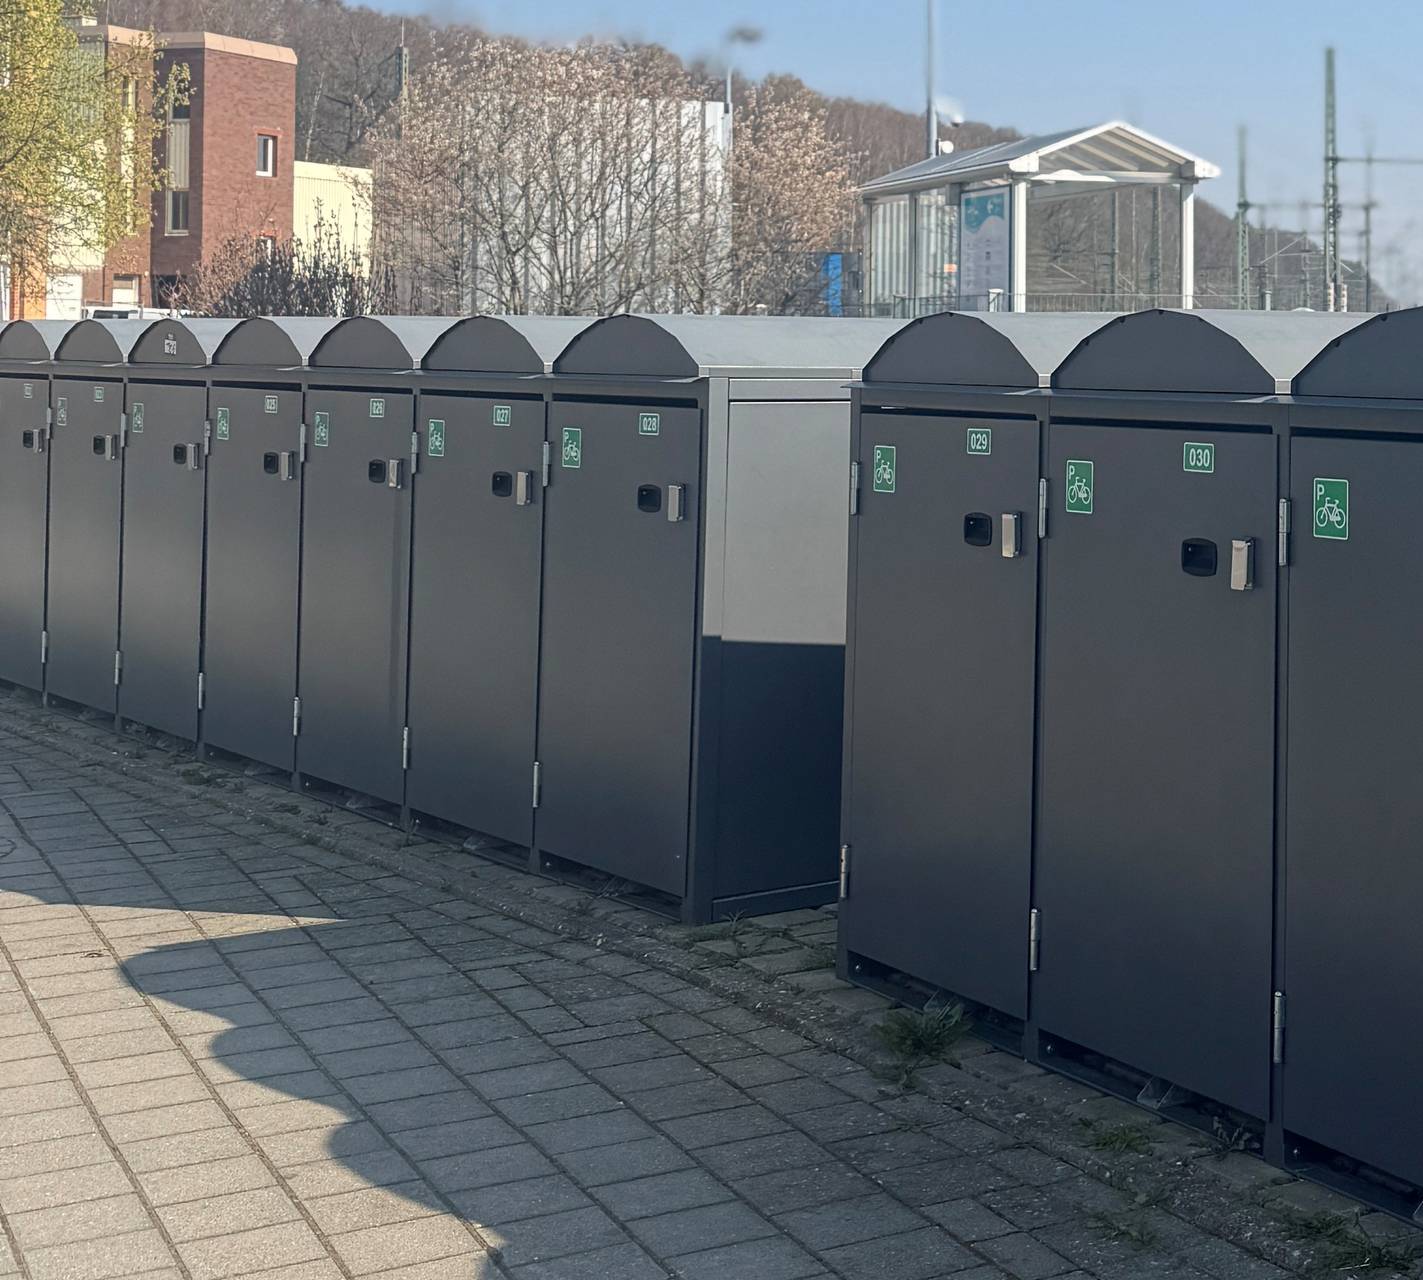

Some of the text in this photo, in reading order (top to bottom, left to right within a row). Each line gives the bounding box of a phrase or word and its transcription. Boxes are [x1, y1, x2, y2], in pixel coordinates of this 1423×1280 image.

[496, 409, 508, 422] 027
[642, 417, 656, 431] 028
[564, 432, 569, 442] P
[970, 433, 987, 450] 029
[876, 450, 881, 462] P
[1189, 448, 1210, 467] 030
[1068, 465, 1075, 480] P
[1316, 484, 1325, 500] P
